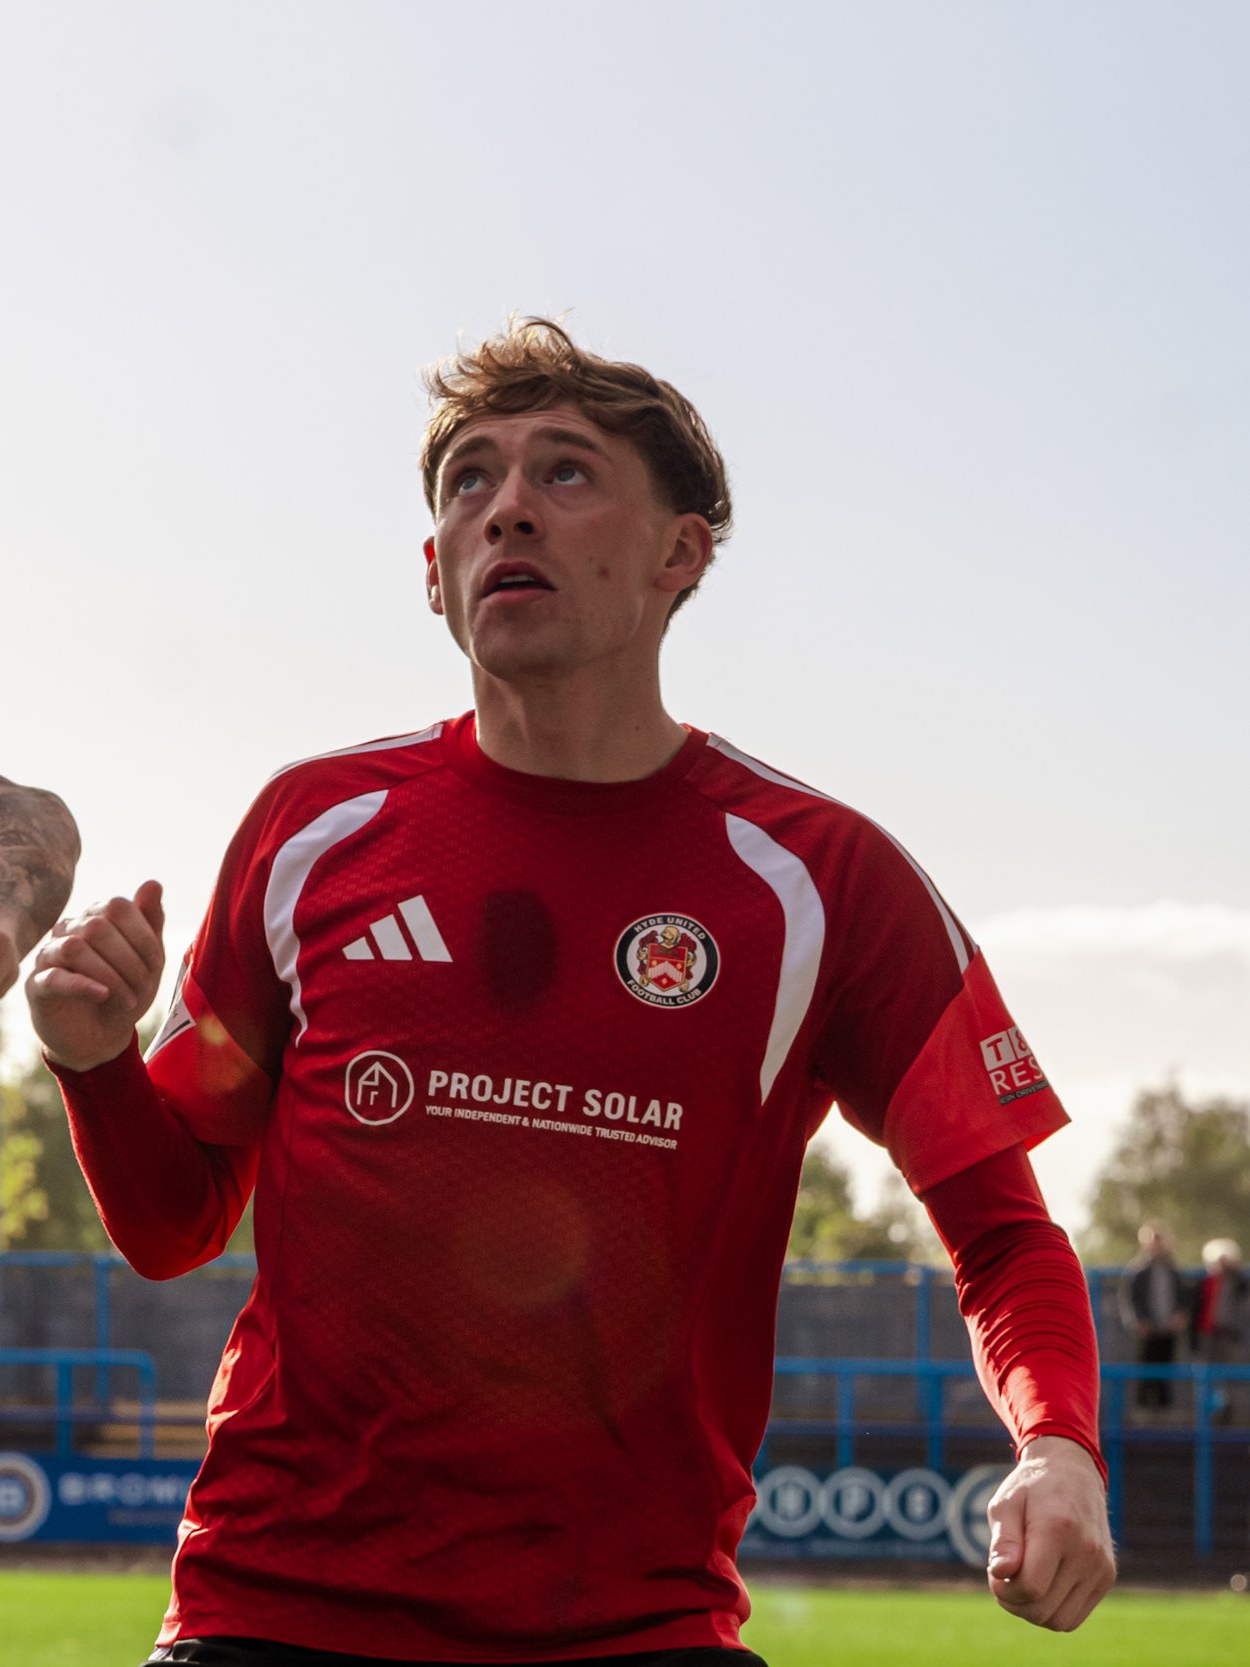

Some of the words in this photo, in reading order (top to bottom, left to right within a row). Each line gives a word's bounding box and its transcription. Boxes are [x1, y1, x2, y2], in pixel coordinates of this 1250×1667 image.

[634, 917, 664, 933] HYDE
[667, 917, 706, 940] UNITED
[627, 979, 675, 1005] FOOTBALL
[676, 988, 702, 1004] CLUB
[427, 1069, 573, 1113] PROJECT
[582, 1088, 684, 1131] SOLAR
[425, 1105, 452, 1118] YOUR
[454, 1108, 521, 1126] INDEPENDENT
[521, 1116, 530, 1127] &
[532, 1119, 593, 1137] NATIONWIDE
[595, 1127, 636, 1142] TRUSTED
[636, 1134, 678, 1150] ADVISOR
